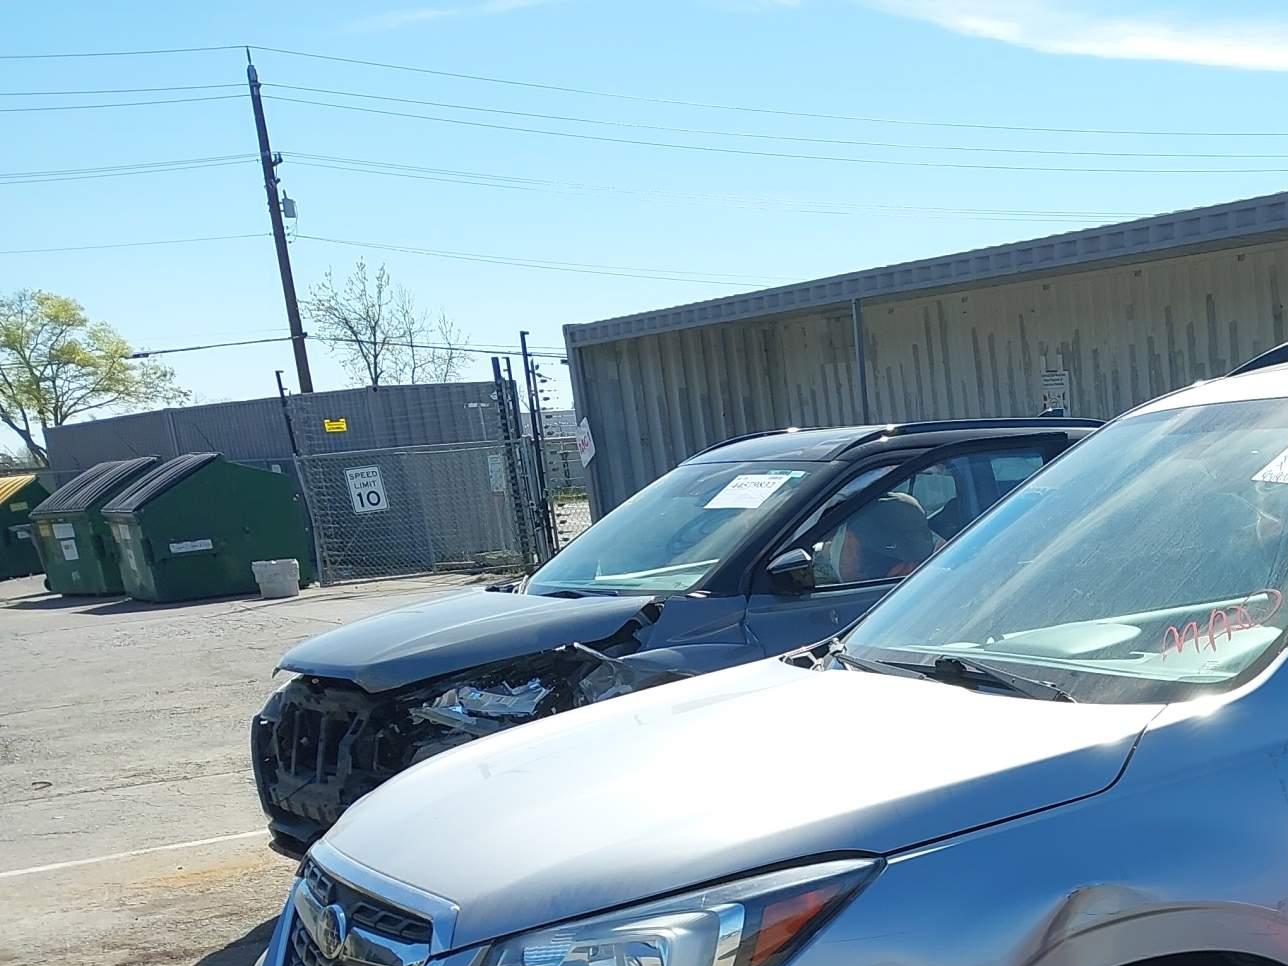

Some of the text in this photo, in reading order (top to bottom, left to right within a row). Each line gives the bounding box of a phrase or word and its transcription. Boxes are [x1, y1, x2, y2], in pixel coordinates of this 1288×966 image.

[349, 471, 377, 480] SPEED
[354, 481, 376, 489] LIMIT
[357, 491, 380, 507] 10
